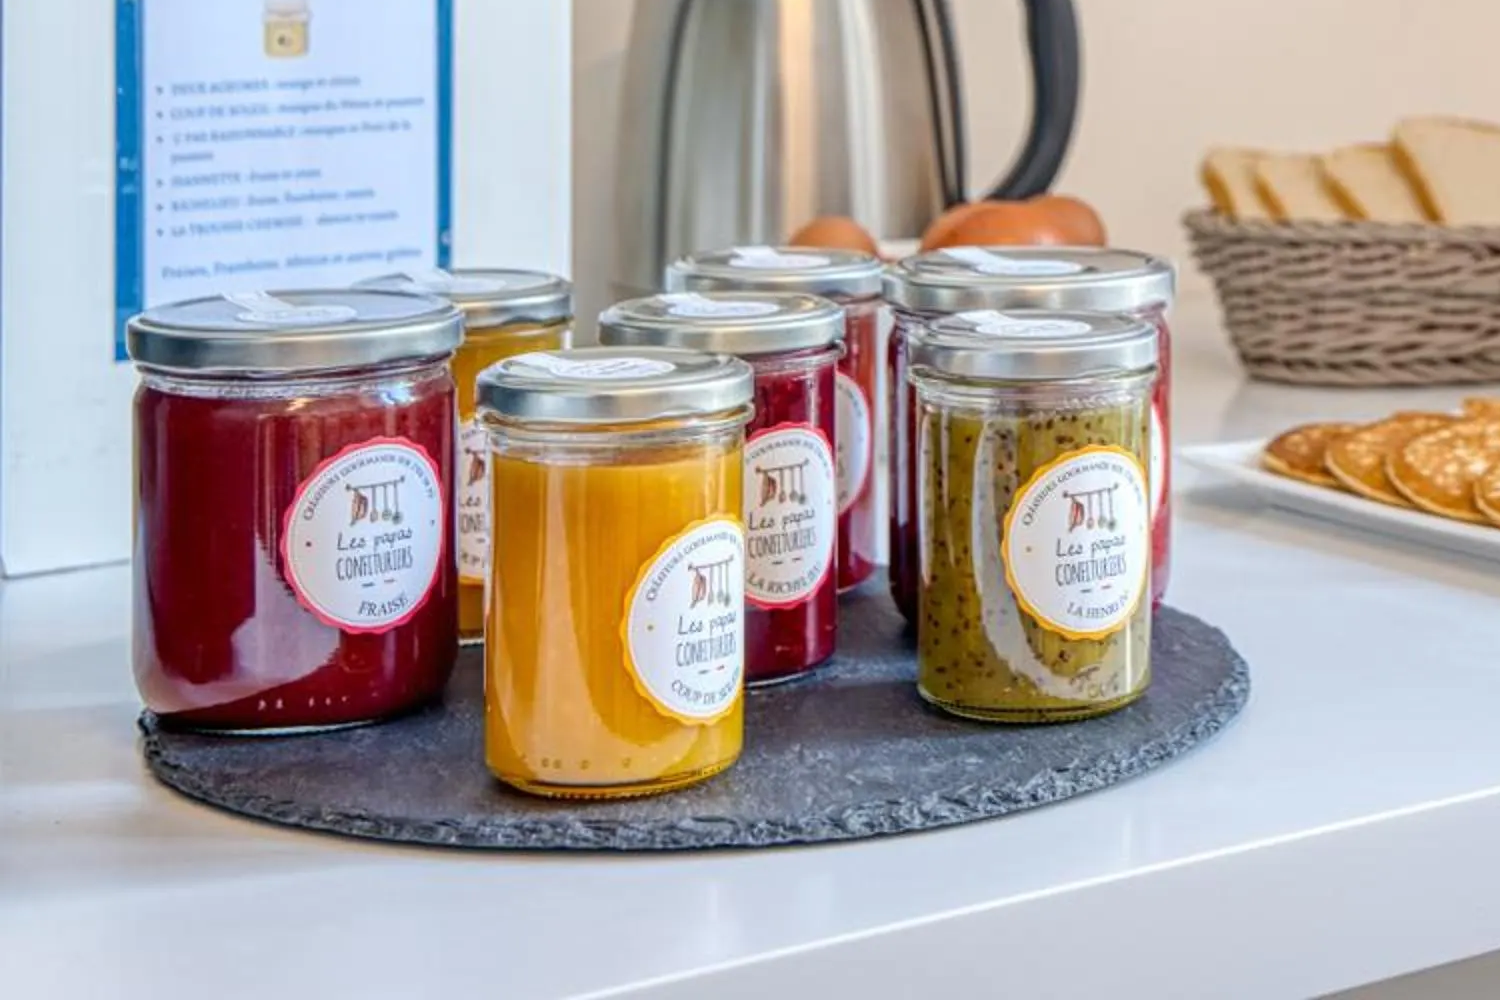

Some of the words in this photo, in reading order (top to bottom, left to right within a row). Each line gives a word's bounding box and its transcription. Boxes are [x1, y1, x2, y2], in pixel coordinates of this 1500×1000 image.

[748, 511, 775, 531] Les
[782, 507, 815, 531] papas
[336, 530, 367, 551] Les
[373, 526, 413, 551] papas
[1055, 537, 1084, 558] Les
[1090, 535, 1127, 558] papas
[358, 594, 410, 617] FRAISE
[1066, 601, 1083, 618] LA
[677, 615, 703, 635] Les
[671, 679, 702, 702] COUP
